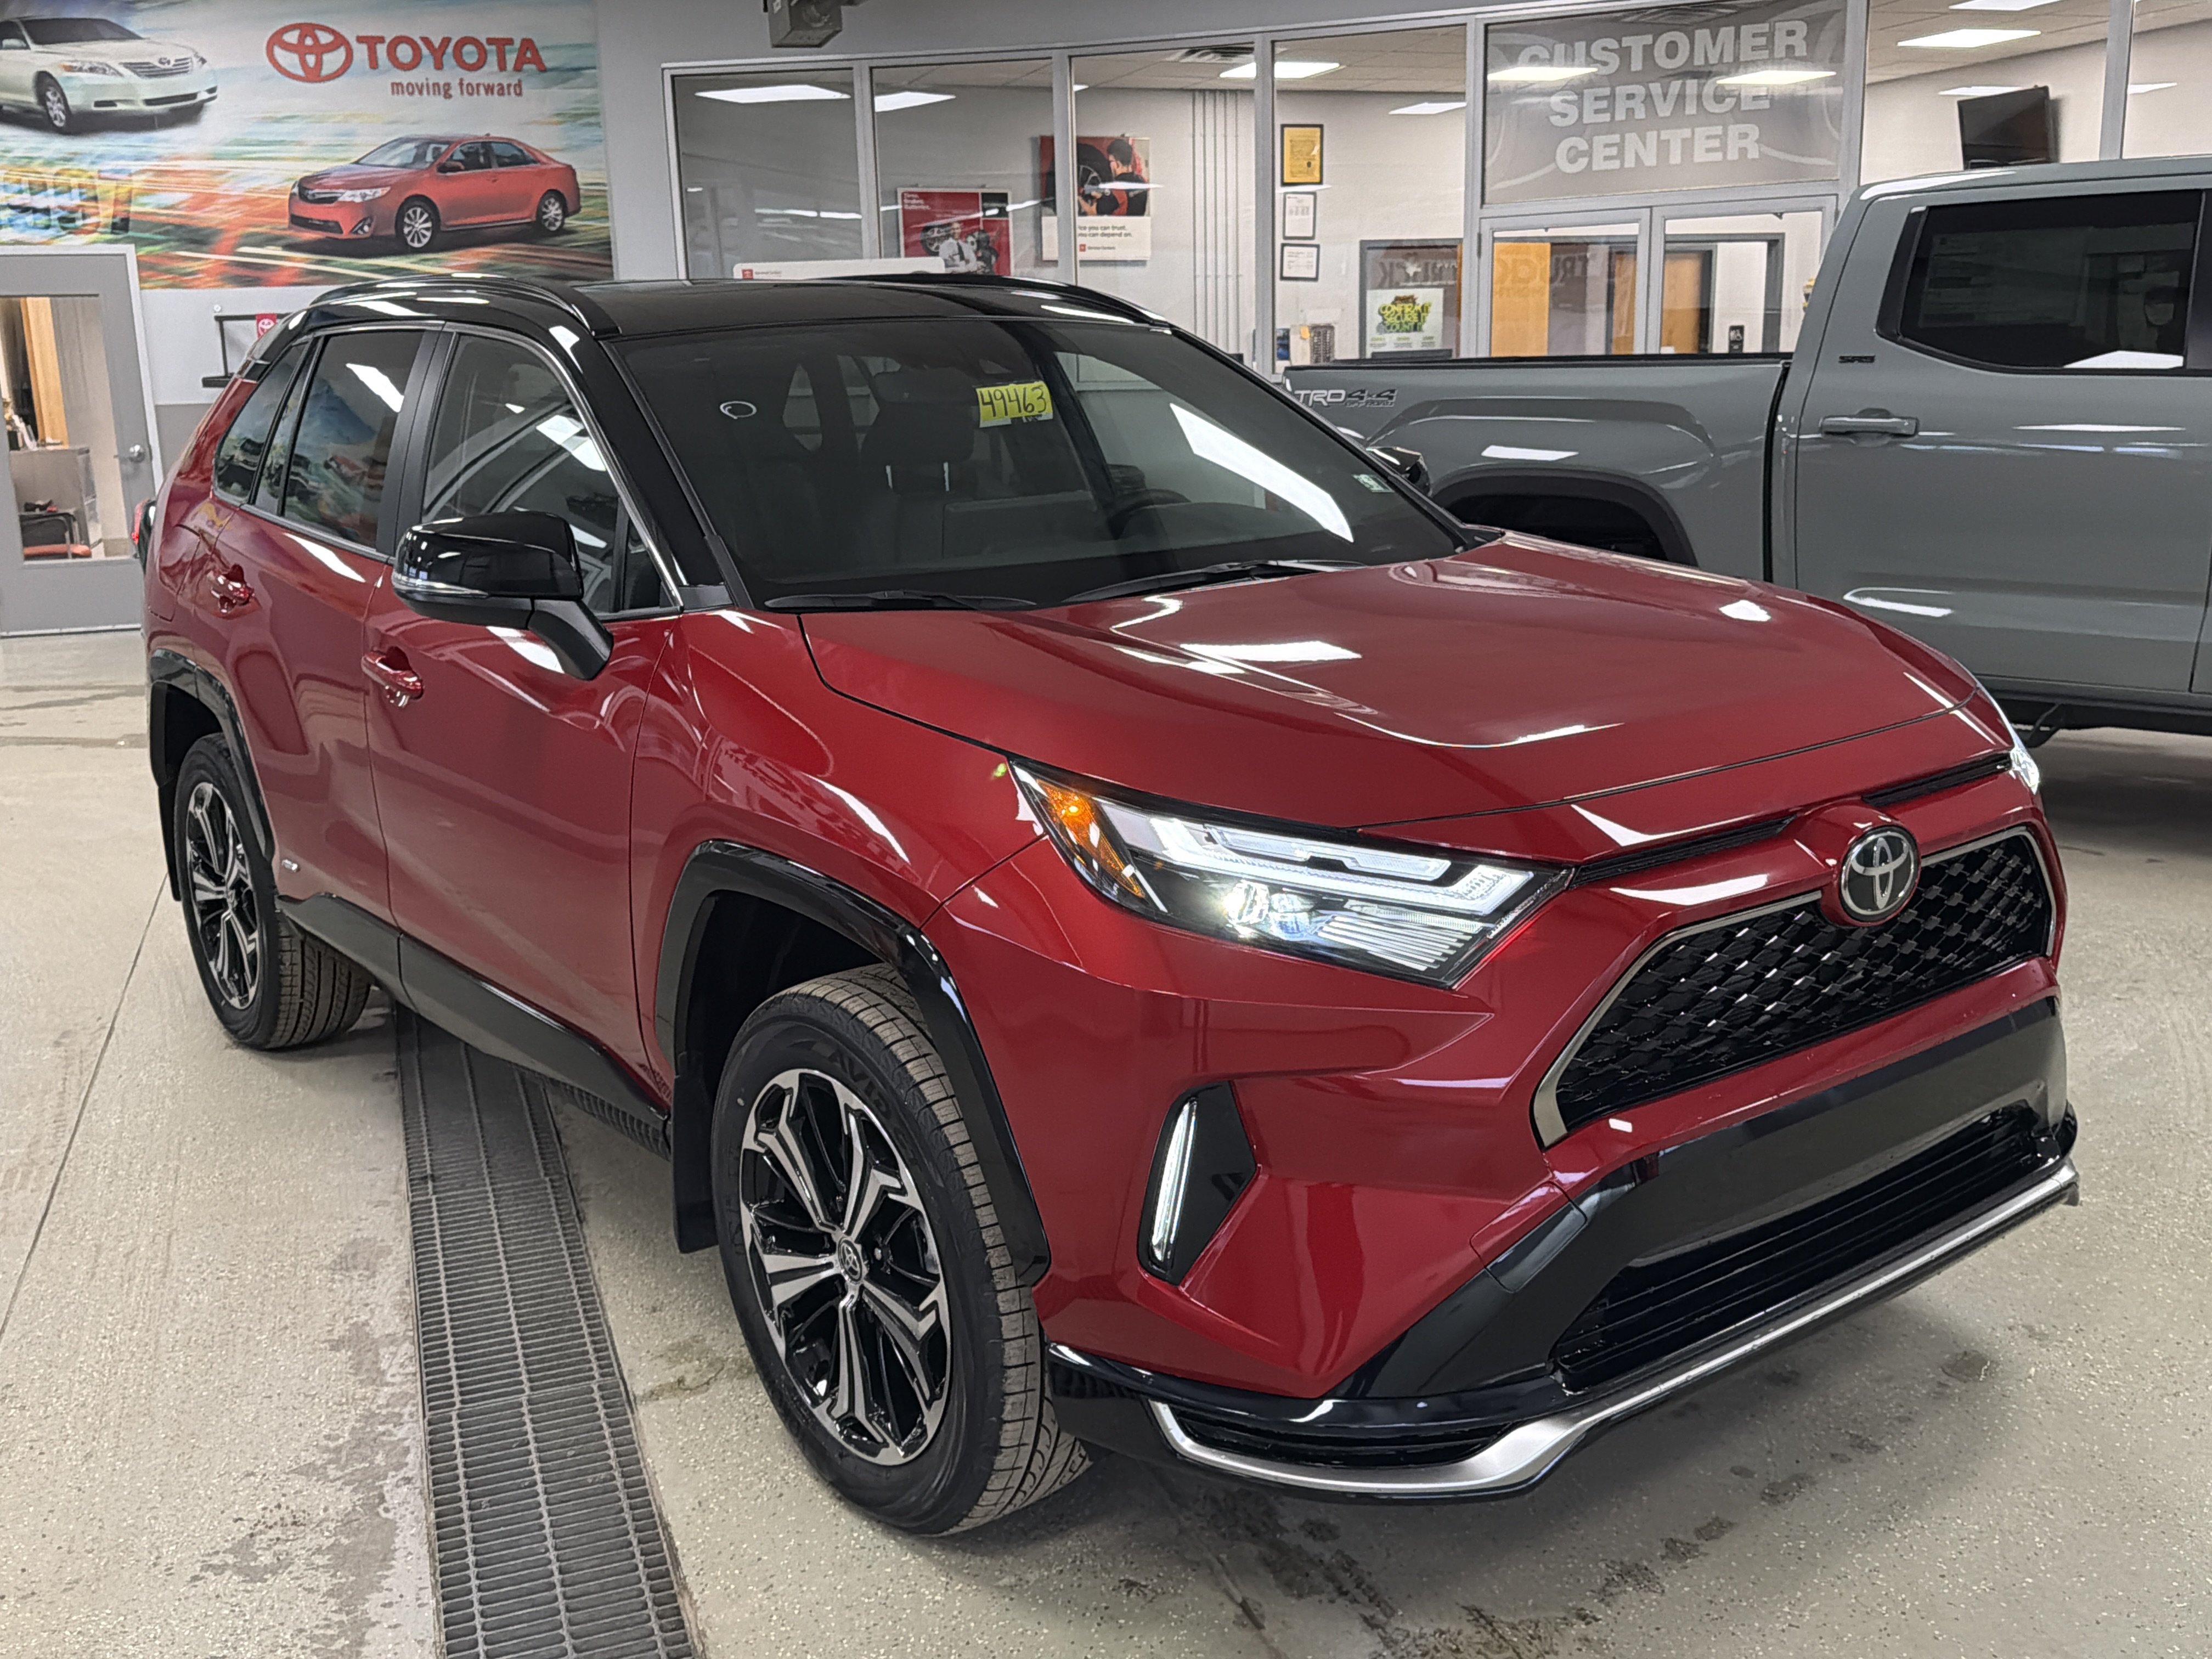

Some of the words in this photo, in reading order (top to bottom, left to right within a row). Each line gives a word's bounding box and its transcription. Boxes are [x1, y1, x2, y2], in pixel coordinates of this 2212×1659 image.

[356, 35, 548, 72] TOYOTA
[1517, 20, 1808, 77] CUSTOMER
[390, 77, 453, 100] moving
[458, 77, 523, 98] forward
[1548, 76, 1771, 127] SERVICE
[1555, 123, 1760, 174] CENTER
[979, 385, 1047, 417] 49463
[1294, 389, 1346, 407] TRD
